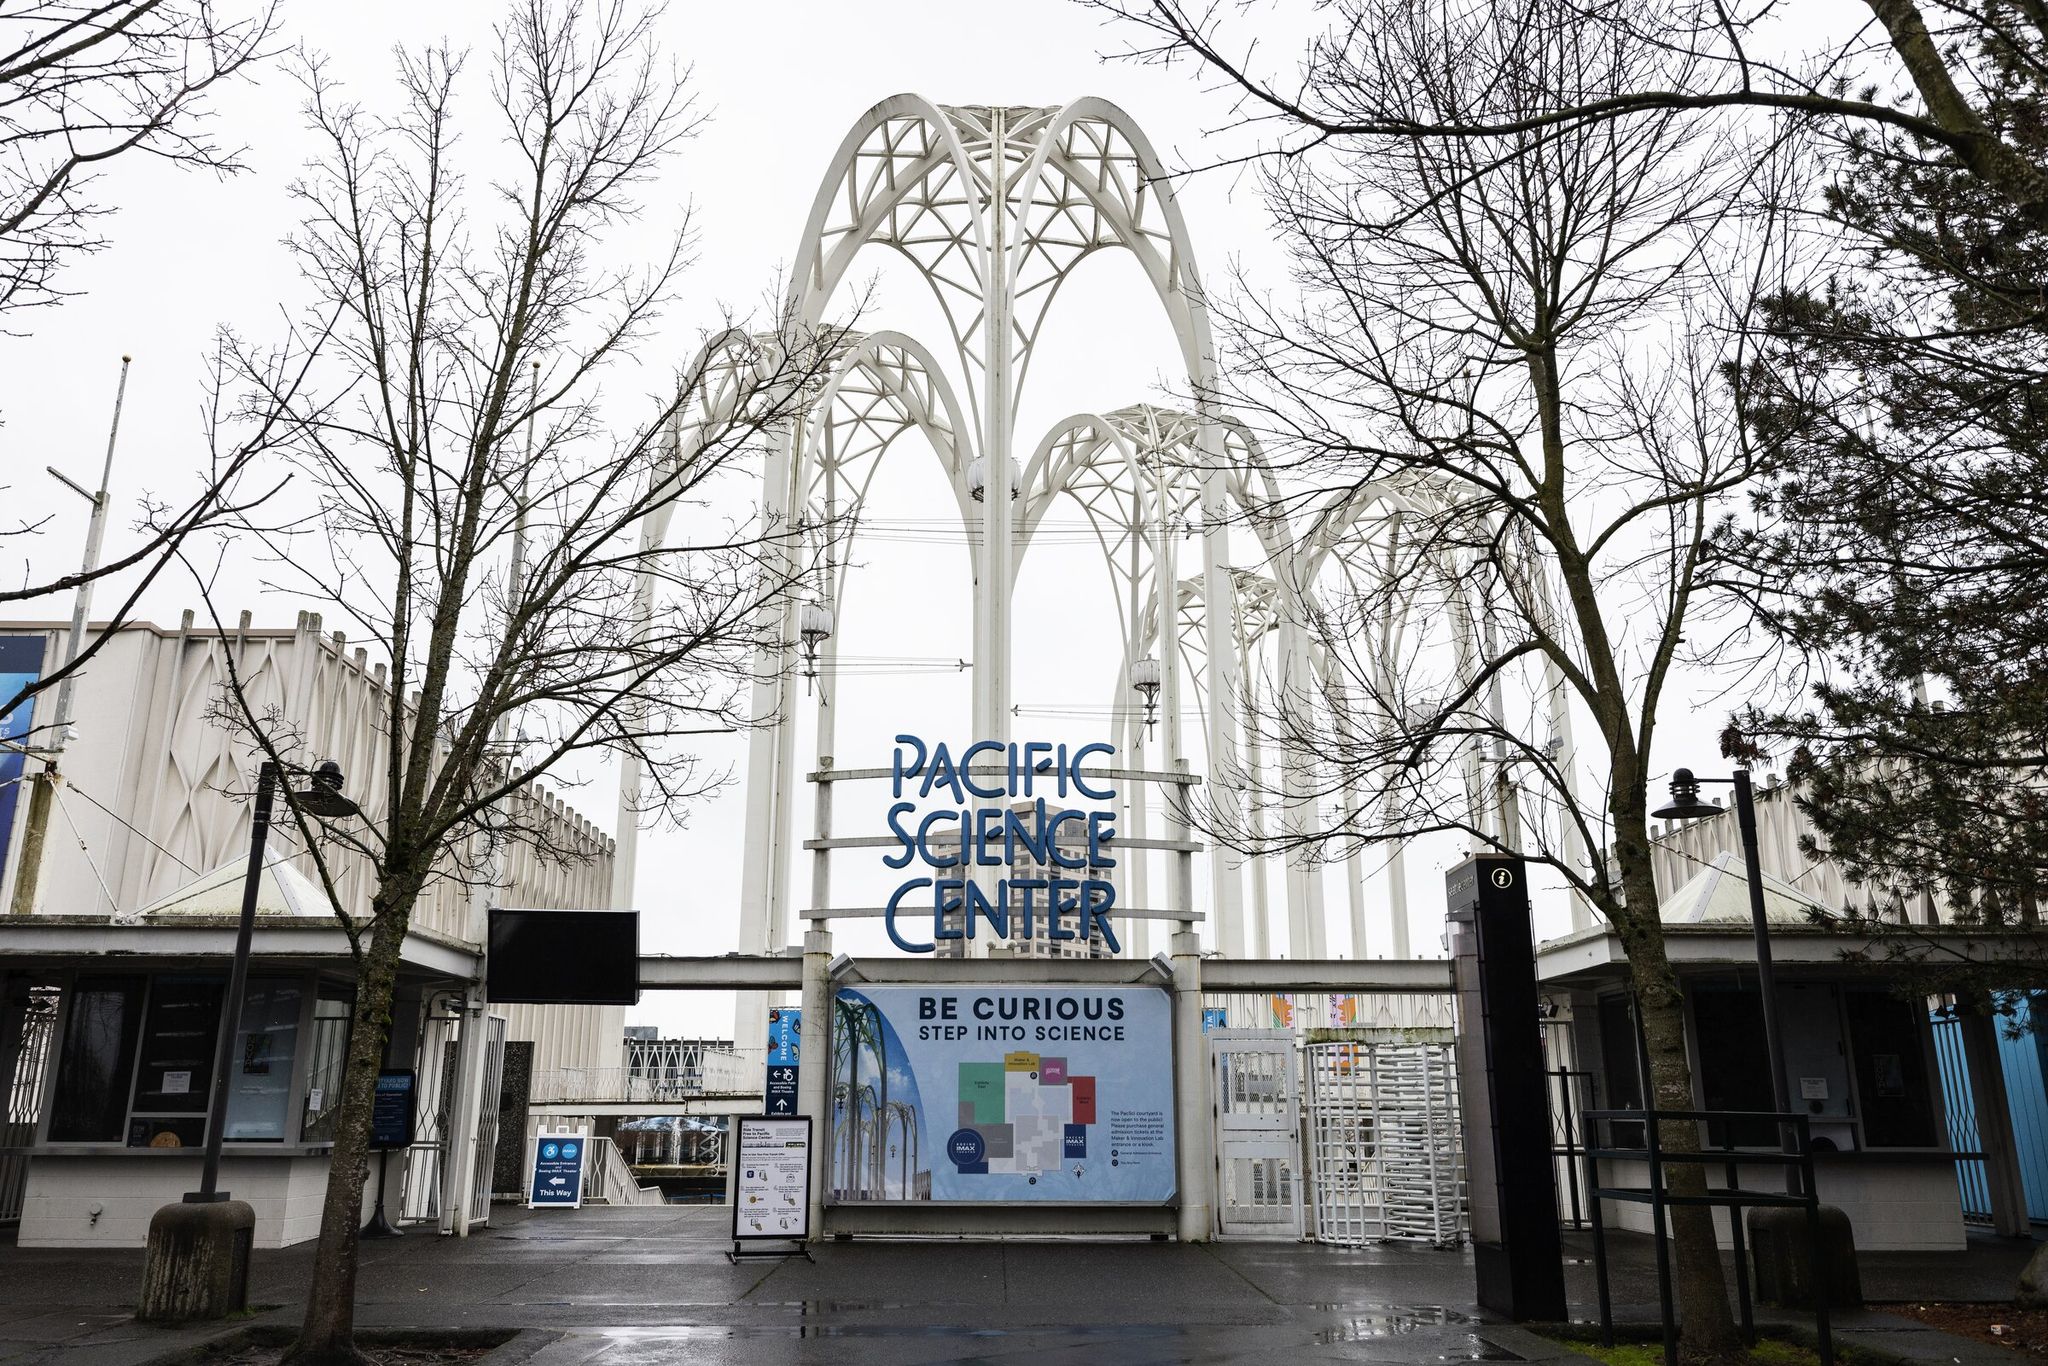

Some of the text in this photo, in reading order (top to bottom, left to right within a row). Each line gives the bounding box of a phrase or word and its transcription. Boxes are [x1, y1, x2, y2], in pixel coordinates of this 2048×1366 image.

[893, 734, 1117, 804] PACIFIC
[882, 797, 1117, 869] SCIENCE
[885, 877, 1121, 953] CENTER
[919, 997, 1125, 1020] BE CURIOUS
[919, 1026, 1125, 1041] STEP INTO SCIENCE
[780, 1015, 789, 1061] WELCOME
